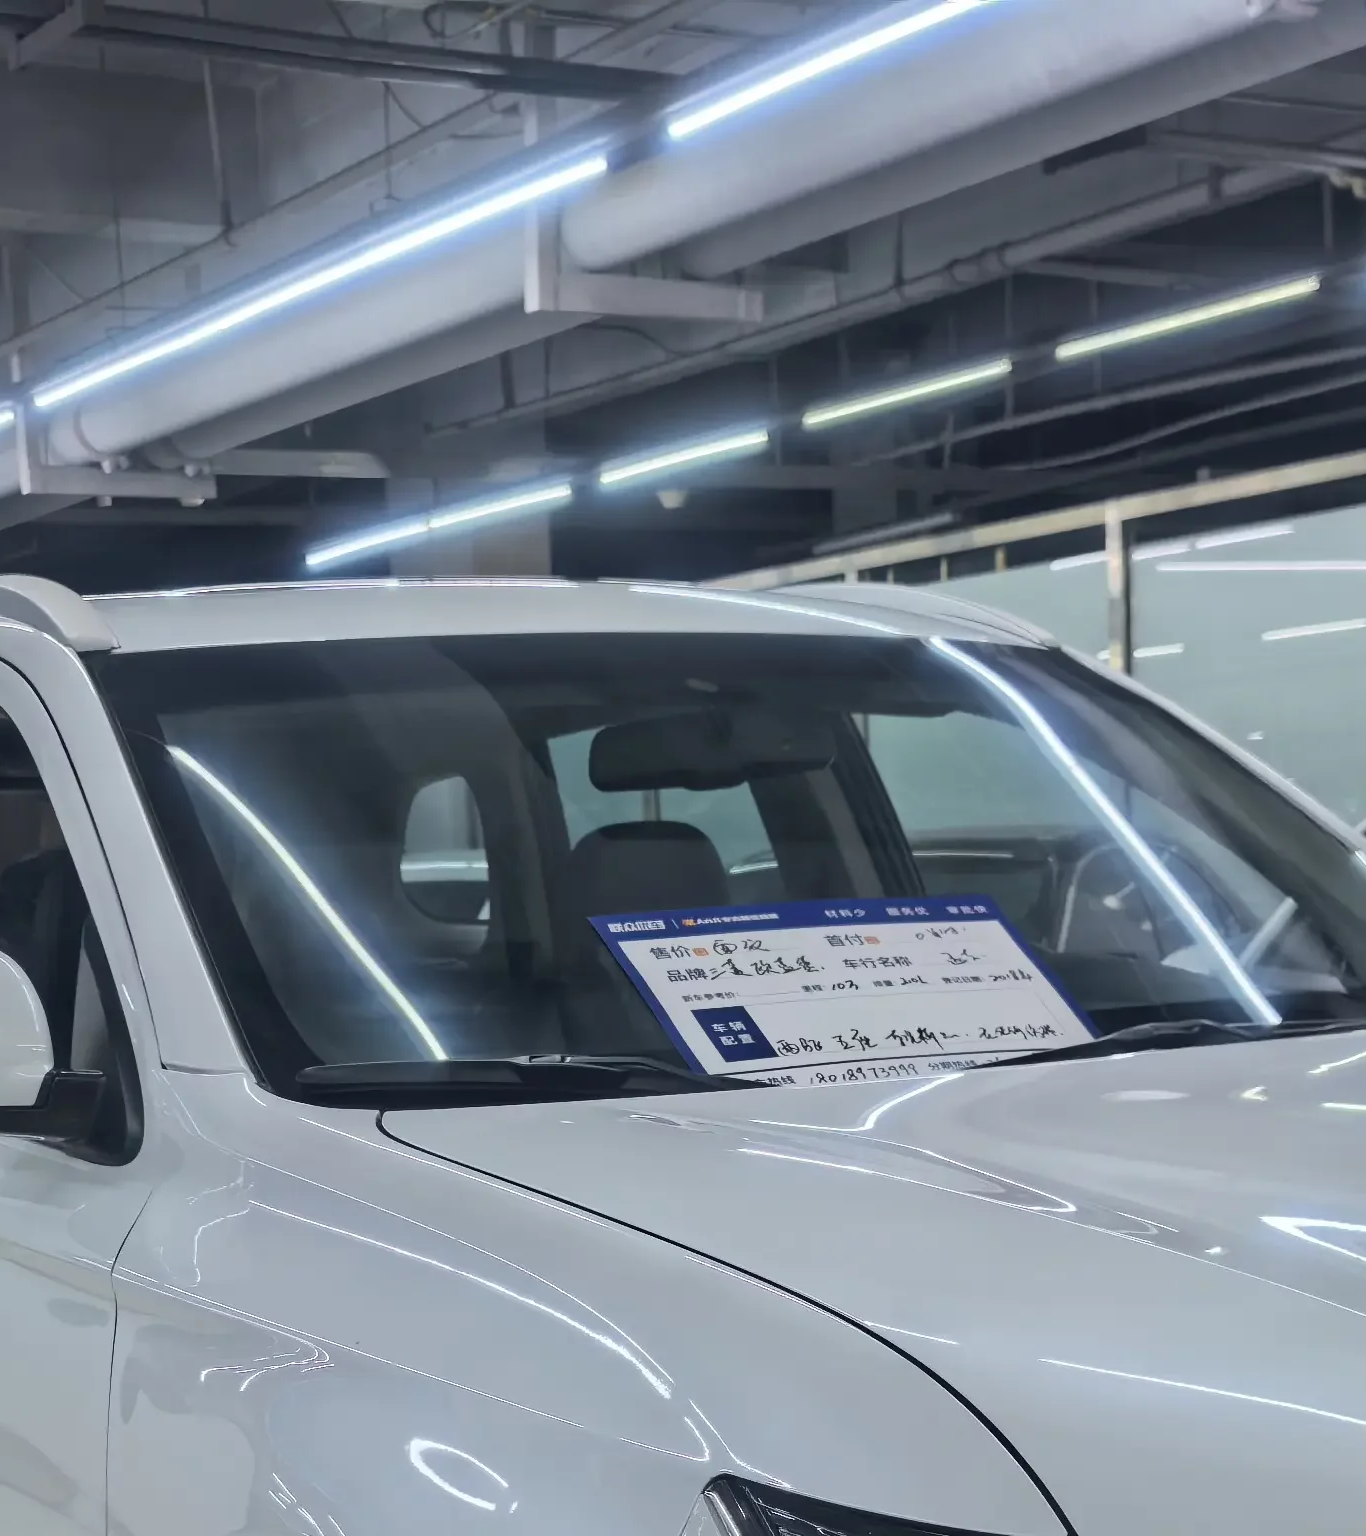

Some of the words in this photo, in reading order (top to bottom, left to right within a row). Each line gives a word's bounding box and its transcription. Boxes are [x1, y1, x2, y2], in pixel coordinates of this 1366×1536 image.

[649, 945, 691, 960] 售价
[823, 933, 866, 948] 首付
[666, 966, 709, 983] 品牌
[842, 956, 913, 970] 车行名称
[711, 1021, 747, 1033] 车辆
[718, 1033, 756, 1046] 配置
